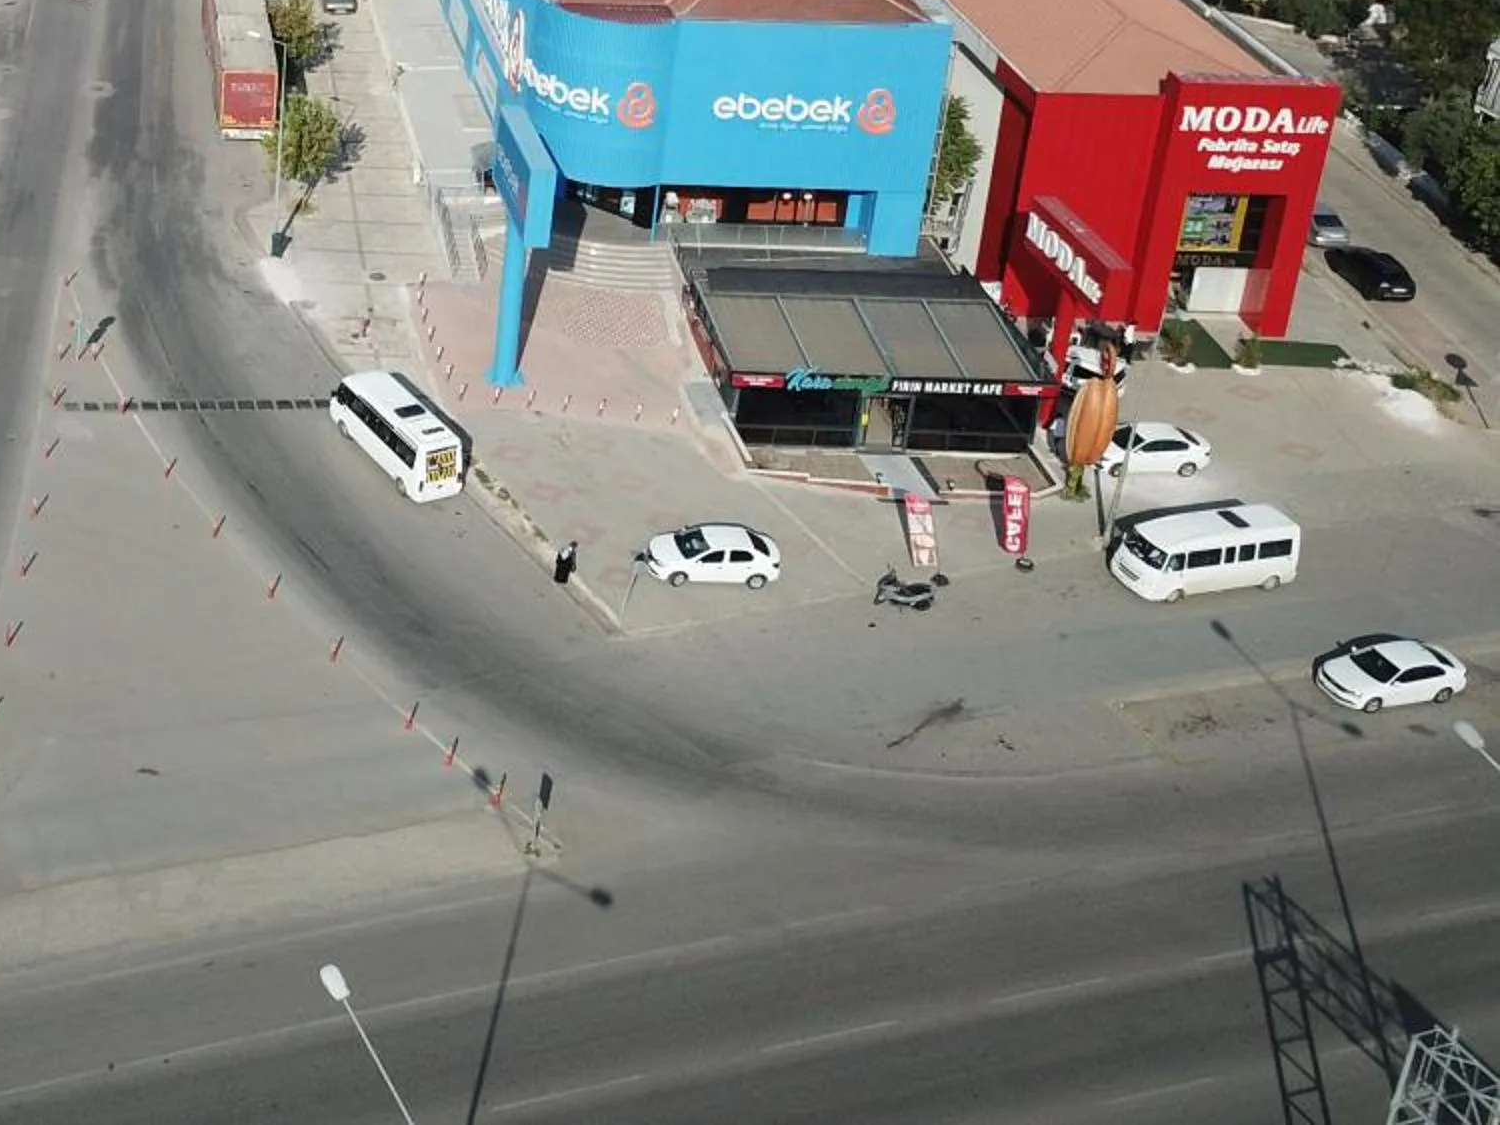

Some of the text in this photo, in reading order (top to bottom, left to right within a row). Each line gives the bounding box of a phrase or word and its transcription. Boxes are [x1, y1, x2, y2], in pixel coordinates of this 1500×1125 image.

[713, 92, 852, 123] ebebek
[924, 381, 972, 395] MARKET
[973, 382, 1003, 396] KAFE
